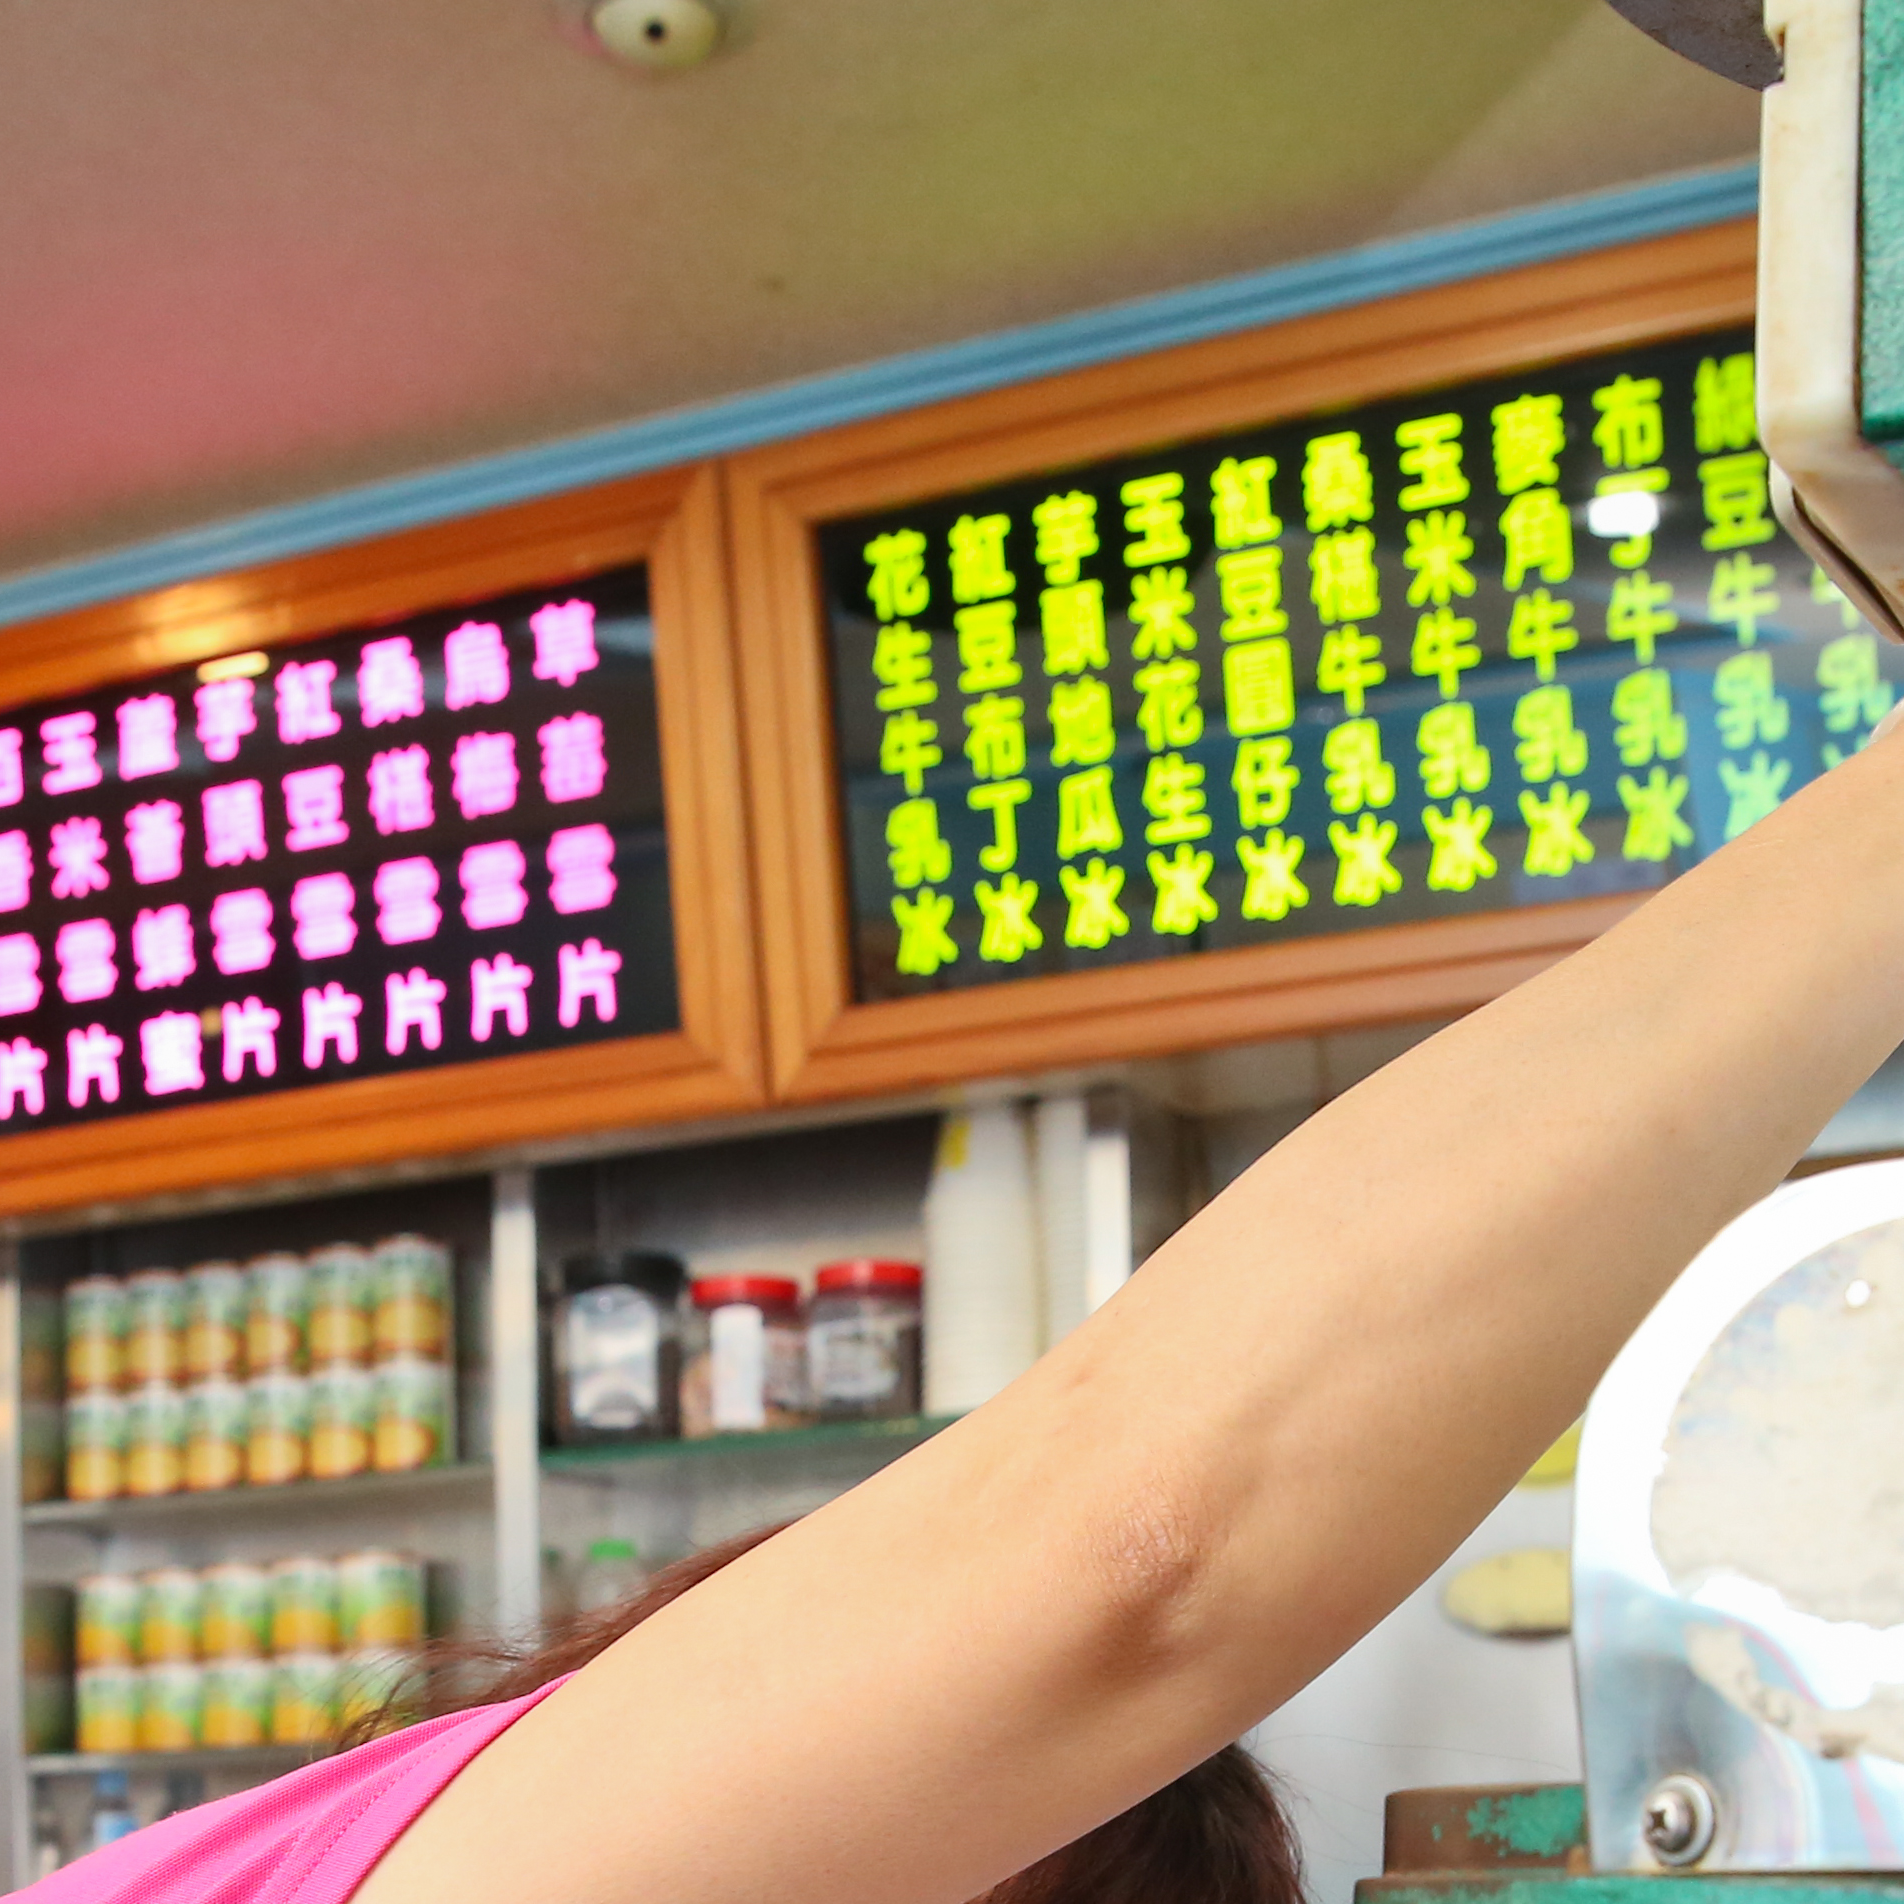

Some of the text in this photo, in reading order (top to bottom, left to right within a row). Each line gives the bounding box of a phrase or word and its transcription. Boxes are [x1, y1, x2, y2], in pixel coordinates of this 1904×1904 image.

[529, 599, 622, 1028] 草莓雪片
[865, 530, 958, 975] 花生牛乳冰
[948, 515, 1043, 962] 紅豆布丁冰
[1033, 491, 1129, 949] 芋頭地瓜冰
[1121, 473, 1218, 935] 玉米花生冰
[1211, 457, 1309, 921] 紅豆圓仔冰
[1396, 413, 1498, 892] 玉米牛乳冰
[1593, 376, 1692, 861] 布丁牛乳冰
[40, 711, 123, 1108] 玉米雪片
[193, 678, 281, 1082] 芋頭雪片
[274, 660, 363, 1069] 紅豆雪片
